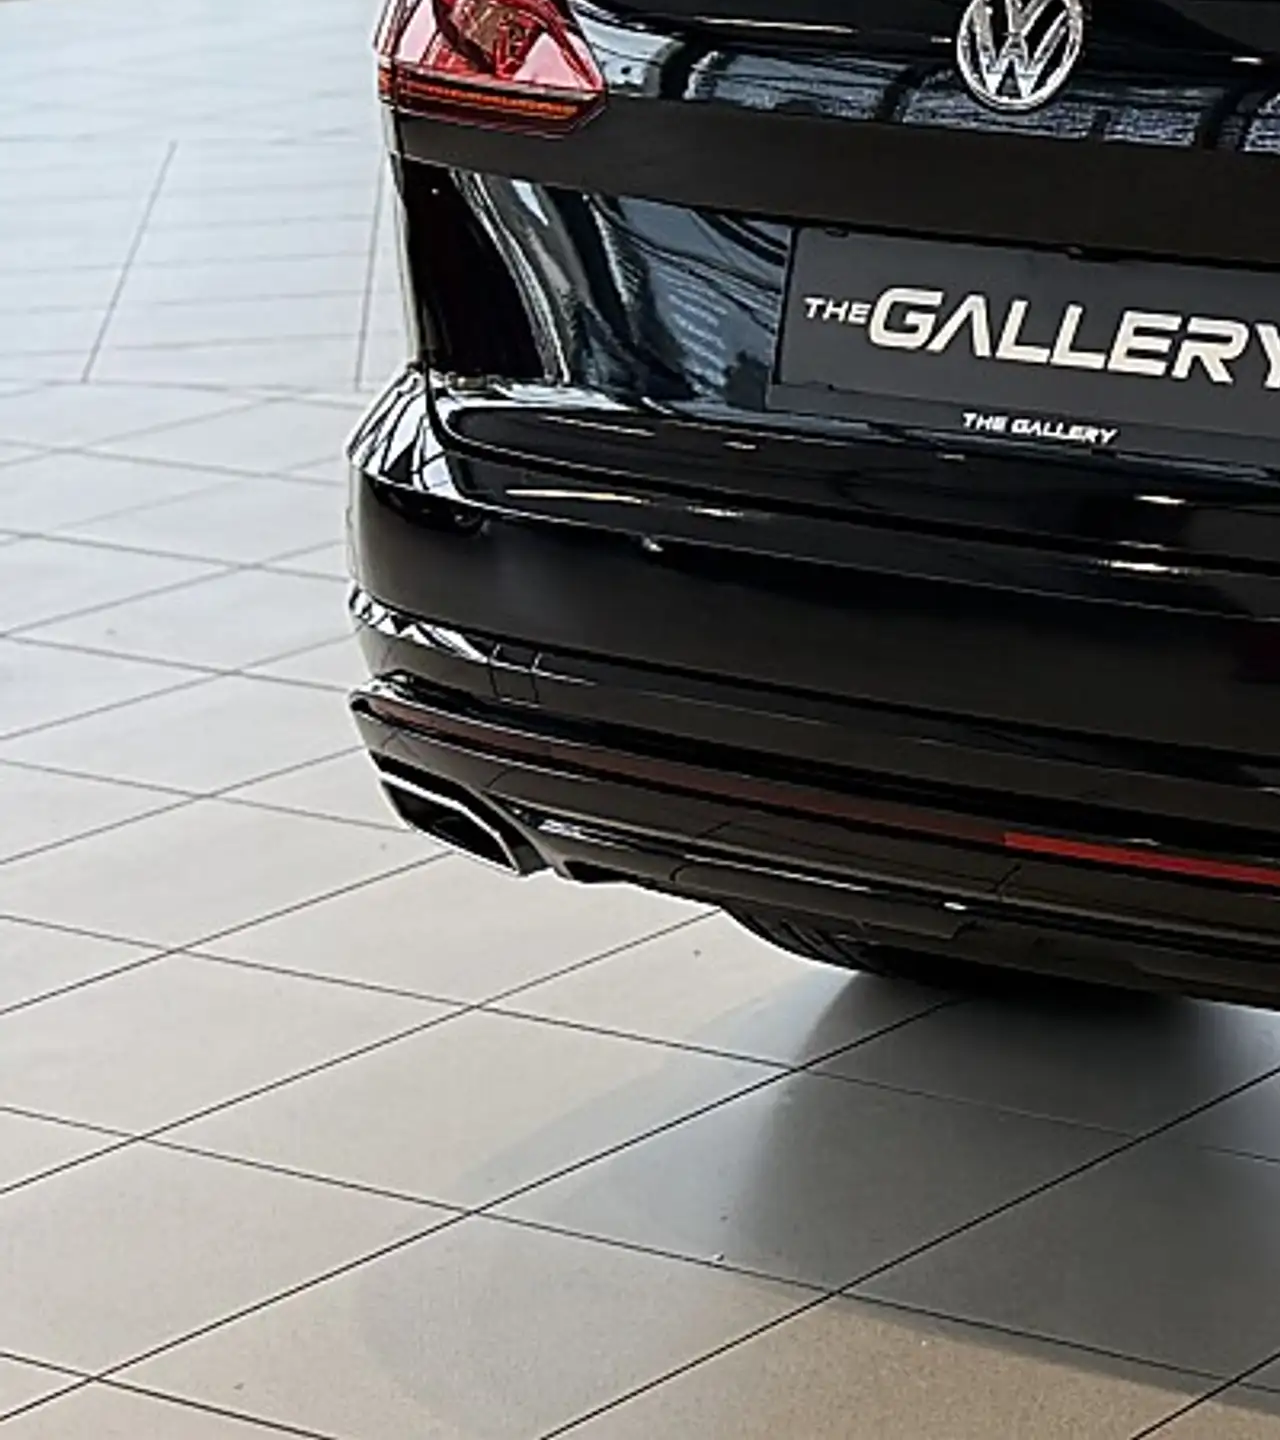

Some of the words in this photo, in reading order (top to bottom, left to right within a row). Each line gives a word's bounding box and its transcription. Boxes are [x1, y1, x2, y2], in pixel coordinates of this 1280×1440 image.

[804, 296, 873, 325] THE
[962, 412, 1008, 433] THE
[1011, 418, 1118, 444] GALLERY
